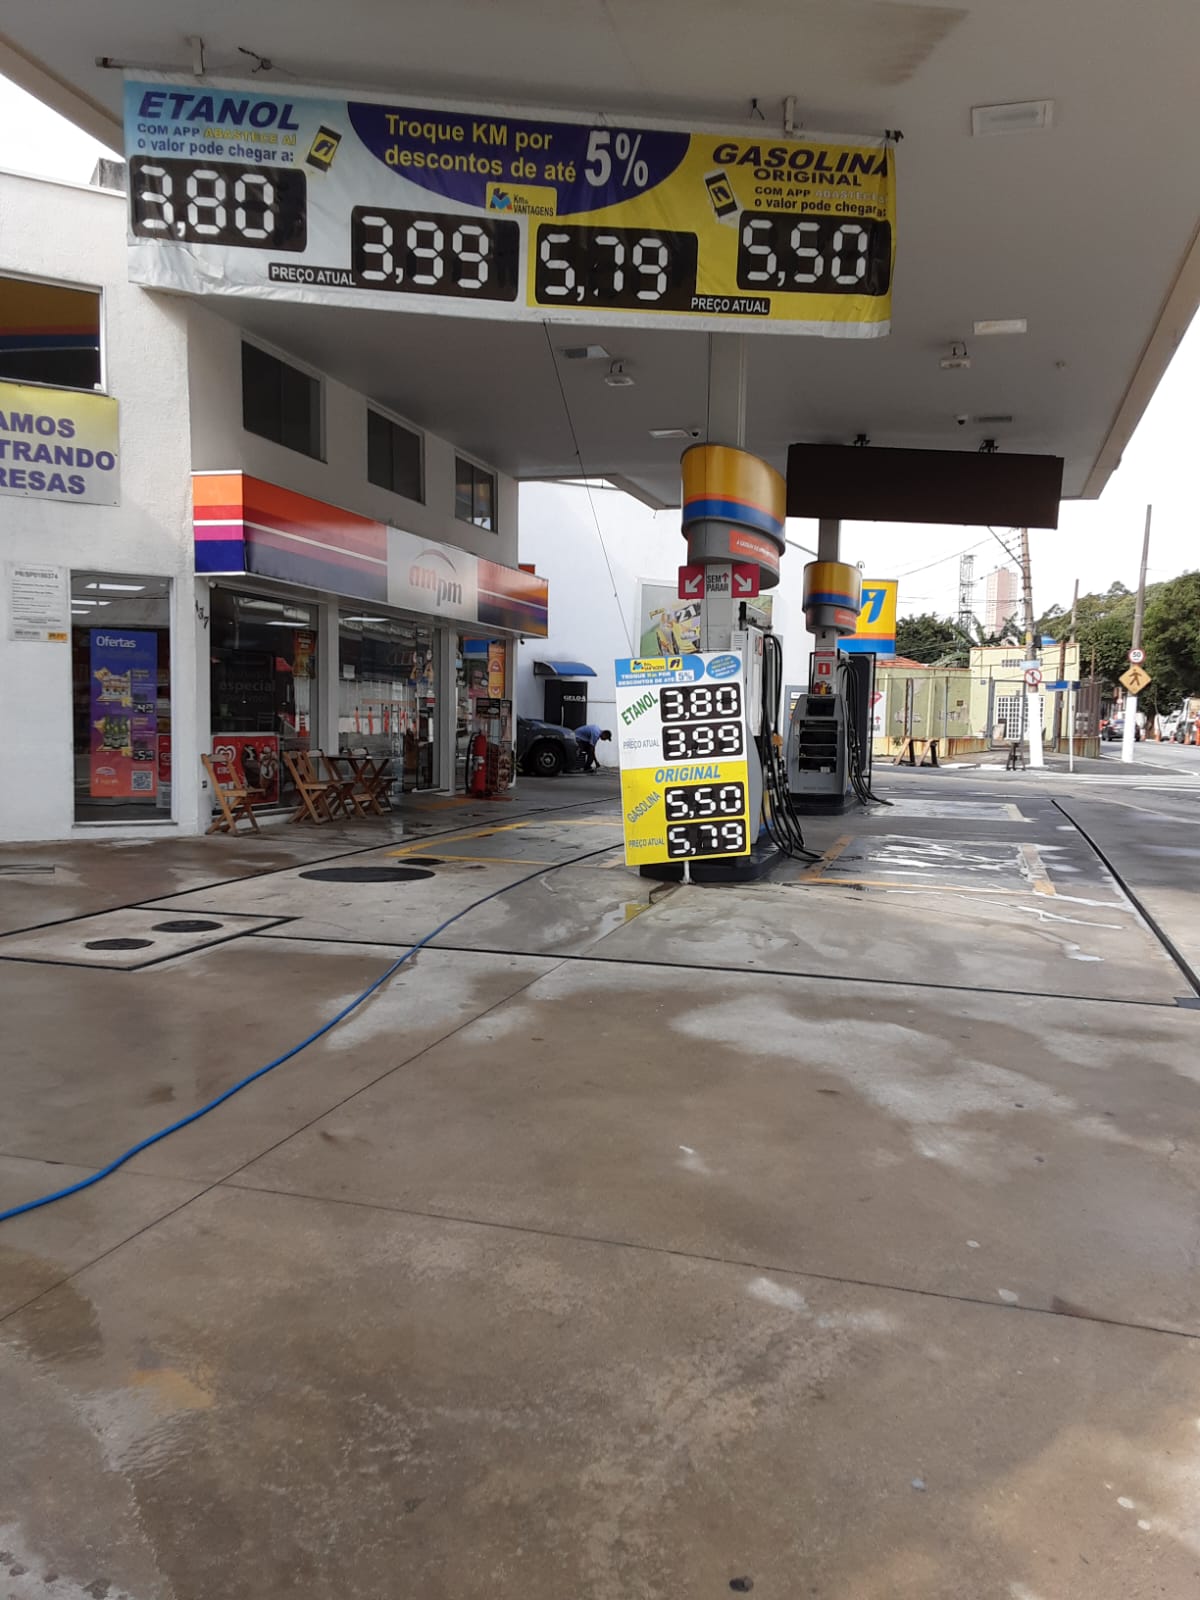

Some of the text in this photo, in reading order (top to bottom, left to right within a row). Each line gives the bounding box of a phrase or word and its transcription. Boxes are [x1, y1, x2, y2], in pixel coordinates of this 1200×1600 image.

[137, 91, 299, 130] ETANOL
[138, 123, 169, 136] COM
[173, 126, 200, 137] APP
[385, 114, 552, 151] Troque KM por
[137, 138, 294, 162] o valor pode chegar a:
[385, 145, 576, 182] descontos de até
[712, 143, 888, 177] GASOLINA
[753, 168, 862, 187] ORIGINAL
[140, 164, 274, 240] 3,80
[754, 198, 762, 207] o
[767, 197, 797, 209] valor
[801, 199, 831, 213] pode
[835, 201, 877, 215] chegar
[755, 186, 783, 197] COM
[786, 188, 811, 198] APP
[513, 204, 554, 217] VANTAGENS
[361, 215, 490, 290] 3,99
[742, 219, 869, 287] 5,50
[271, 266, 356, 286] PREÇO ATUAL
[540, 233, 669, 301] 5,79
[690, 296, 768, 313] PREÇO ATUAL
[706, 575, 721, 583] SEM
[706, 583, 729, 592] PARAR
[96, 636, 137, 649] Ofertas
[621, 691, 659, 725] ETANOL
[664, 687, 738, 720] 3,80
[623, 737, 660, 750] PREÇO ATUAL
[666, 725, 740, 757] 3,99
[654, 765, 721, 783] ORIGINAL
[627, 791, 662, 823] GASOLINA
[666, 785, 741, 818] 5,50
[628, 837, 665, 849] PREÇO ATUAL
[668, 823, 743, 855] 5,79
